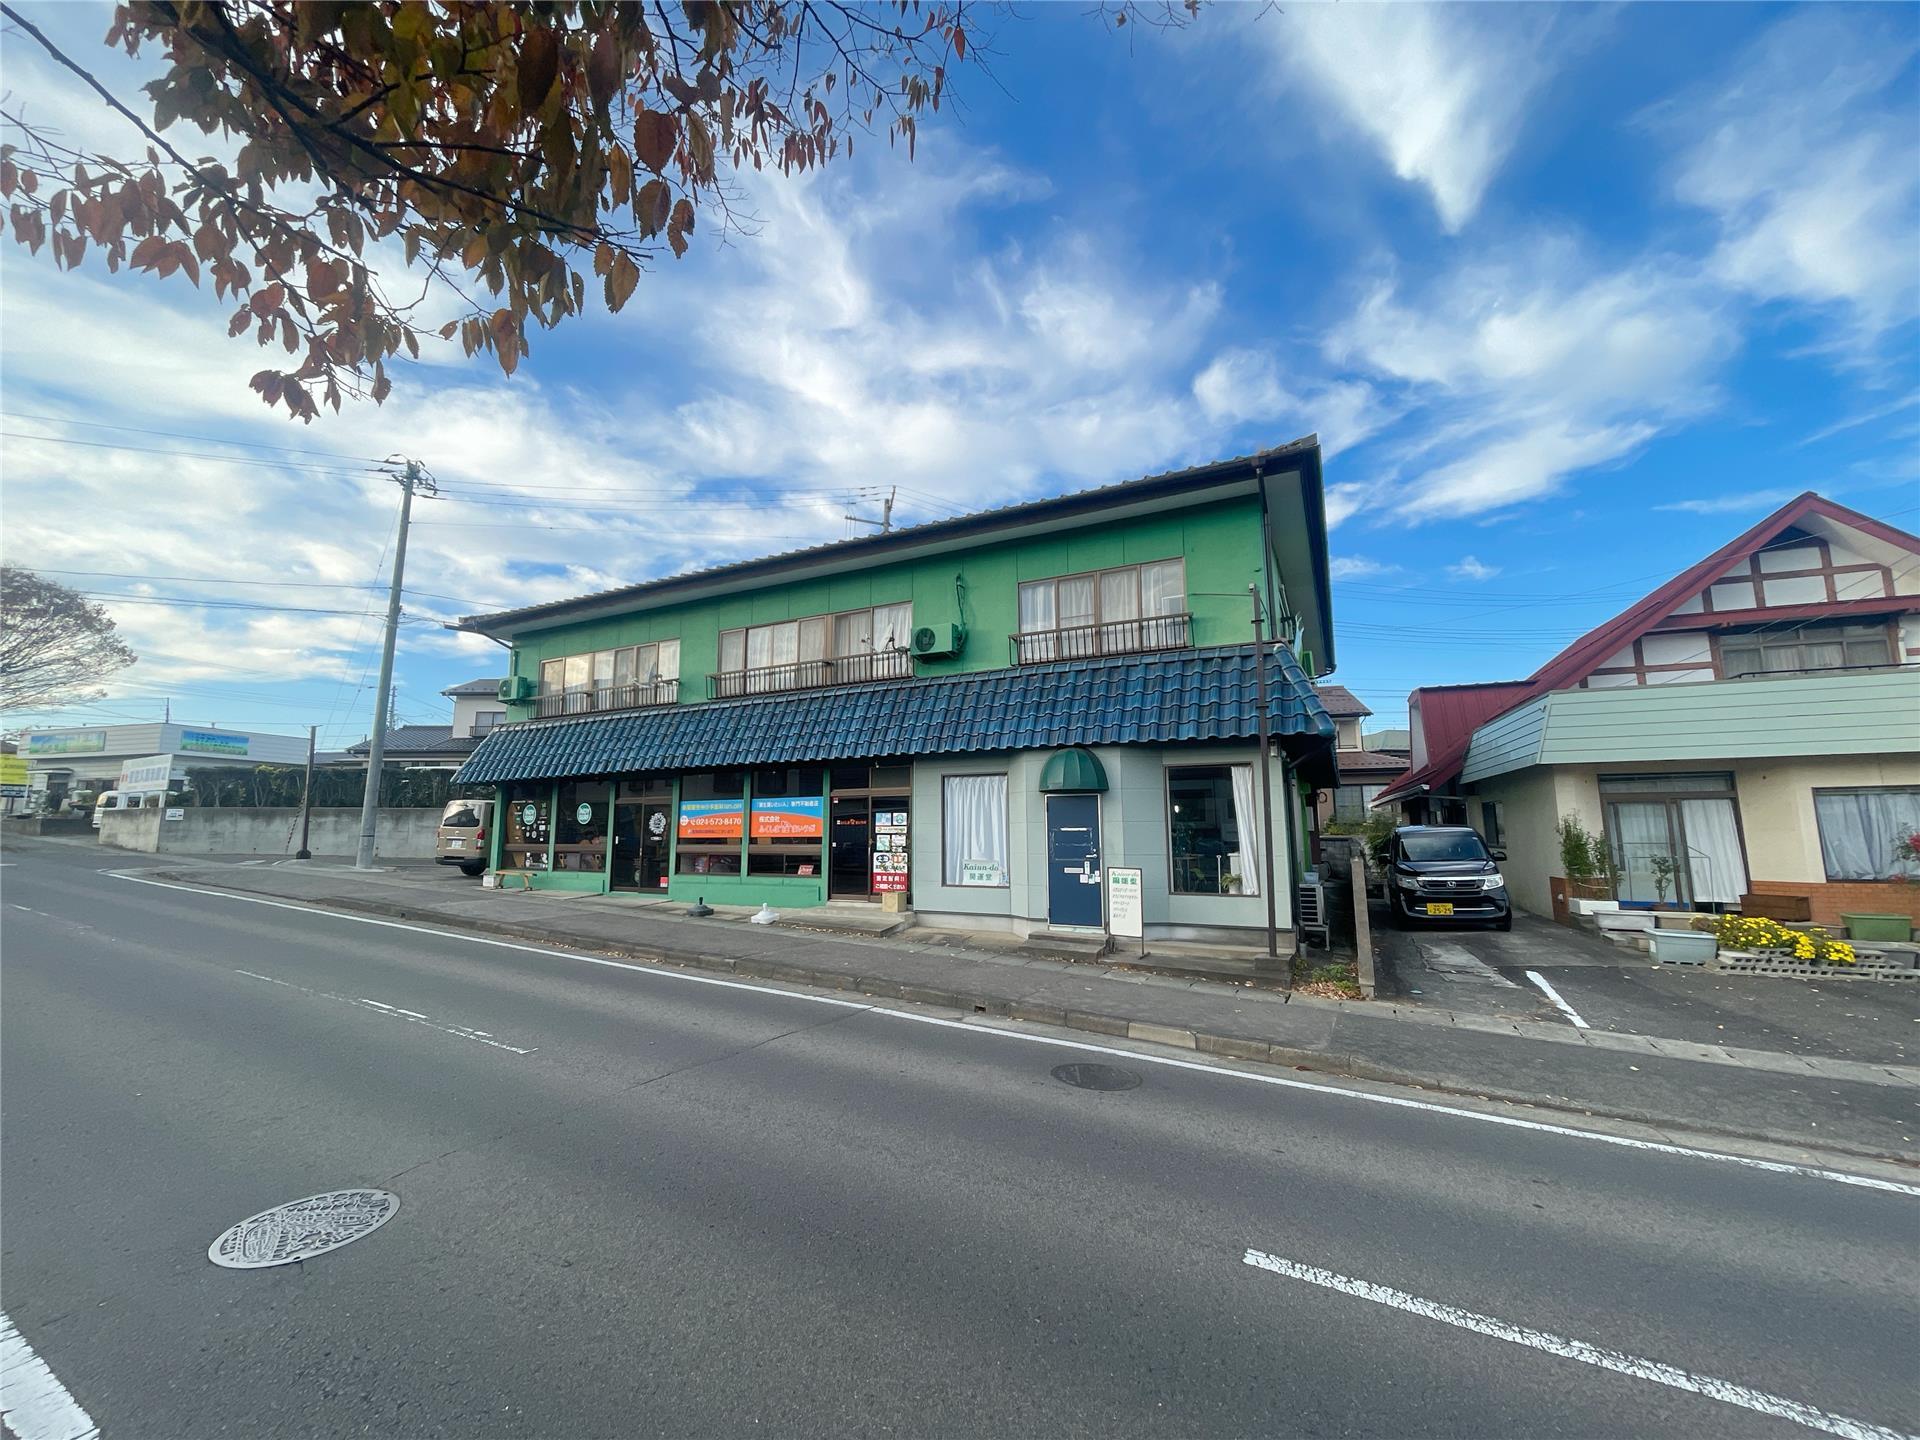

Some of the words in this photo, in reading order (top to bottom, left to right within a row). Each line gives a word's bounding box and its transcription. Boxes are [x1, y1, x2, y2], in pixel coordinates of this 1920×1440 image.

[695, 817, 742, 826] 024-573-8470
[758, 815, 781, 823] 株式会社
[963, 863, 999, 872] Kaiun-do
[969, 873, 993, 881] 開運堂
